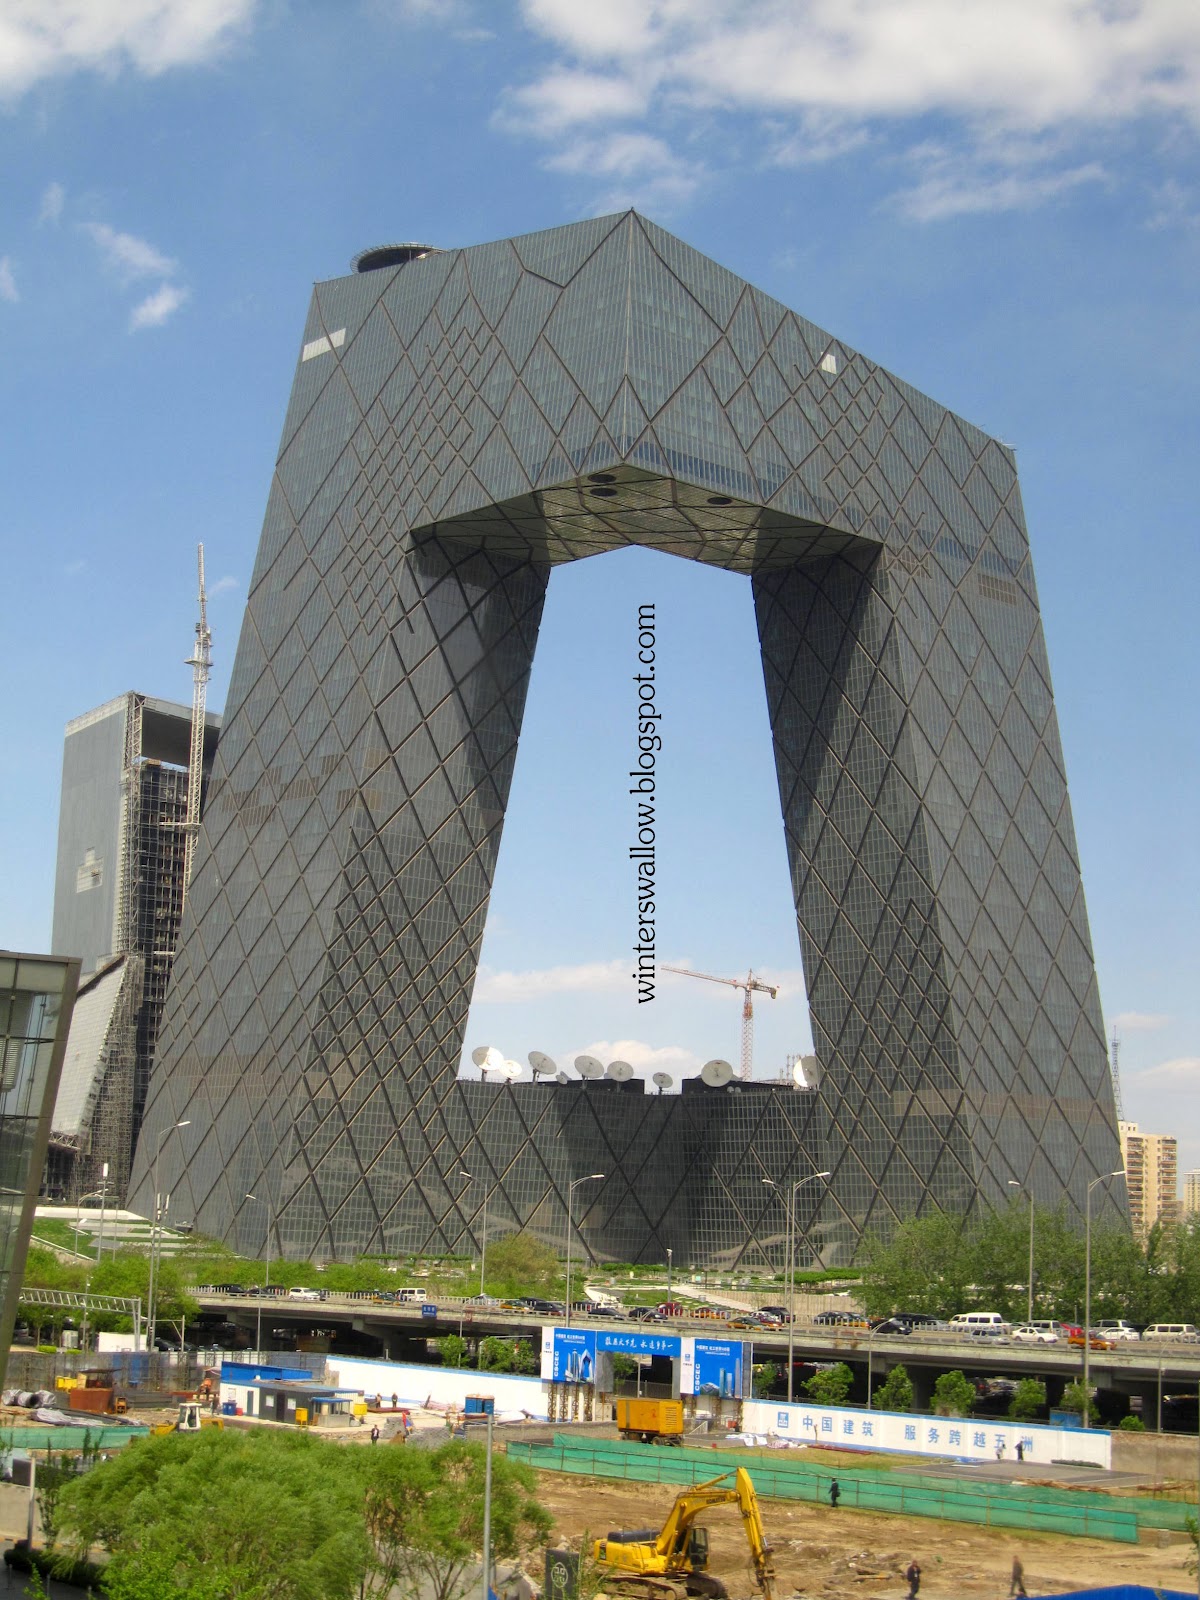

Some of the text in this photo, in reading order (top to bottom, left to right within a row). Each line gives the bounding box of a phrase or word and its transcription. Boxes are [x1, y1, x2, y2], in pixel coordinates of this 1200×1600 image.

[803, 1415, 1033, 1453] 中国建筑 服务跨越五洲
